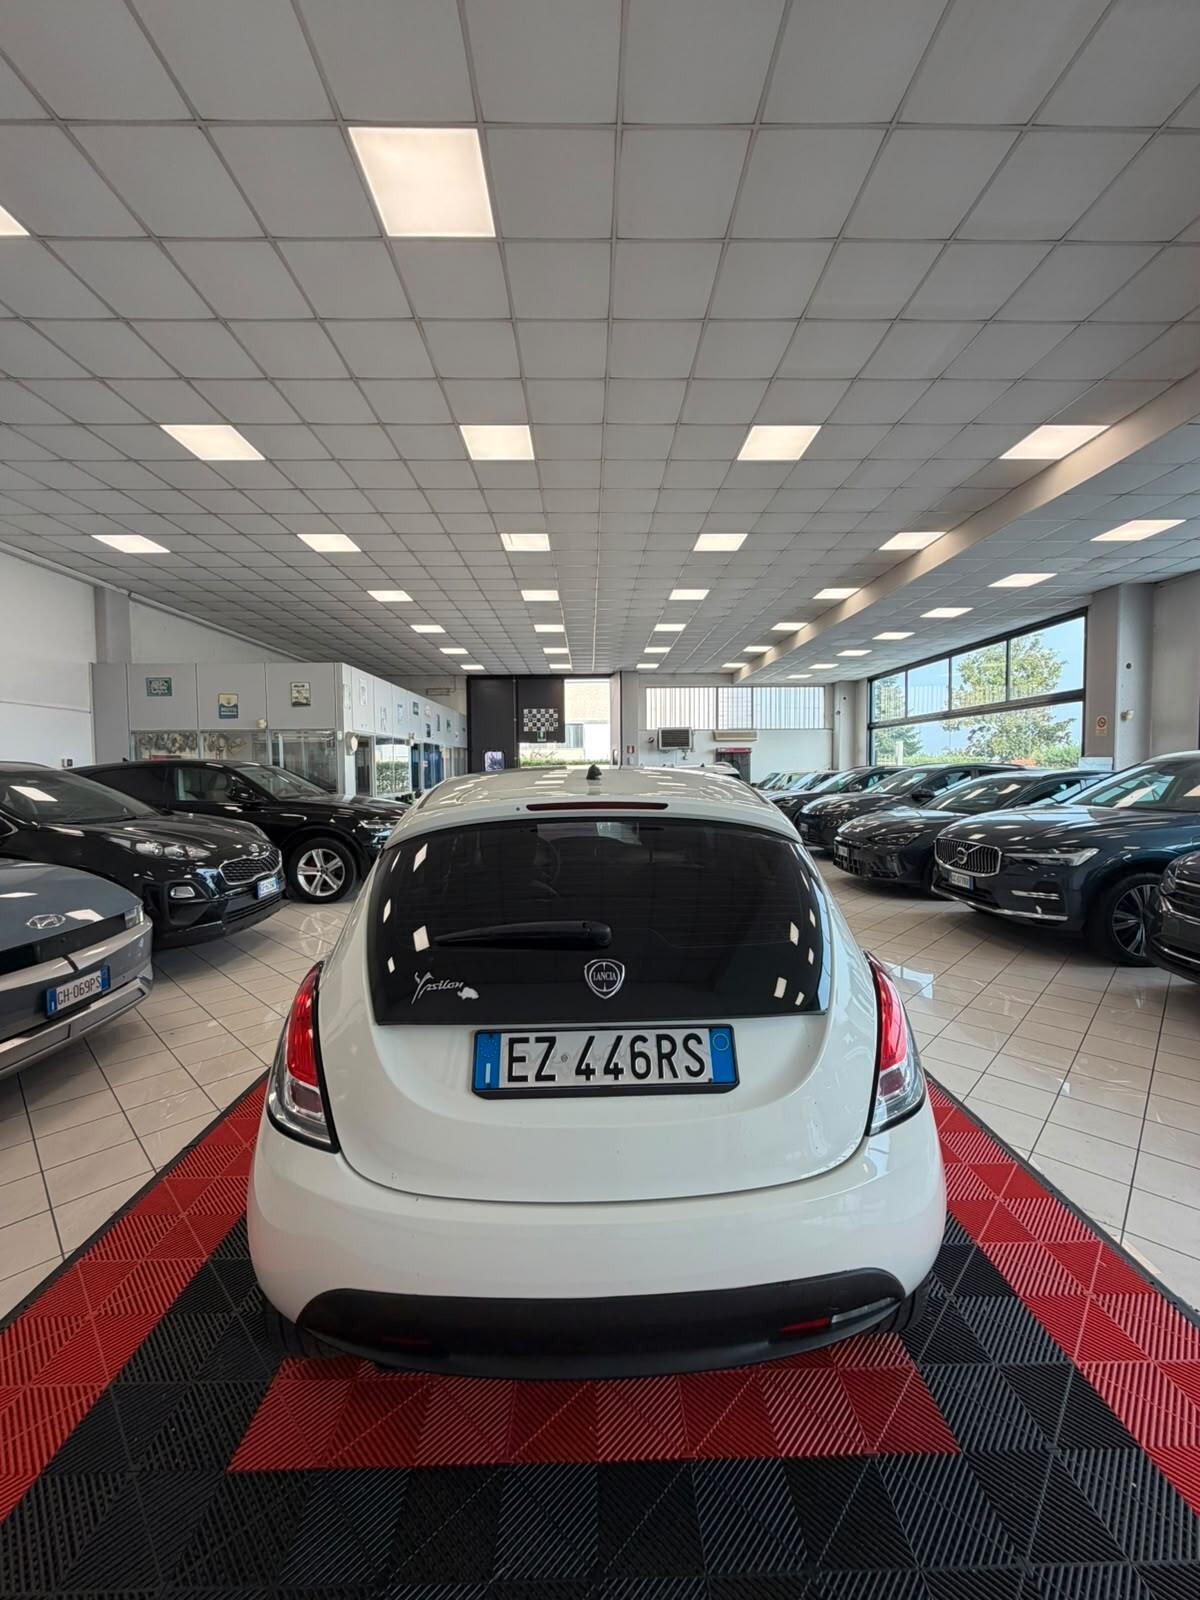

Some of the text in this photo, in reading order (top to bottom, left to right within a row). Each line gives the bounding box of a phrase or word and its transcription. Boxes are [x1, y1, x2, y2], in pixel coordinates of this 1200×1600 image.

[411, 972, 464, 1005] Ypsilon
[593, 972, 617, 981] LANCIA
[507, 1032, 706, 1084] EZ 446RS
